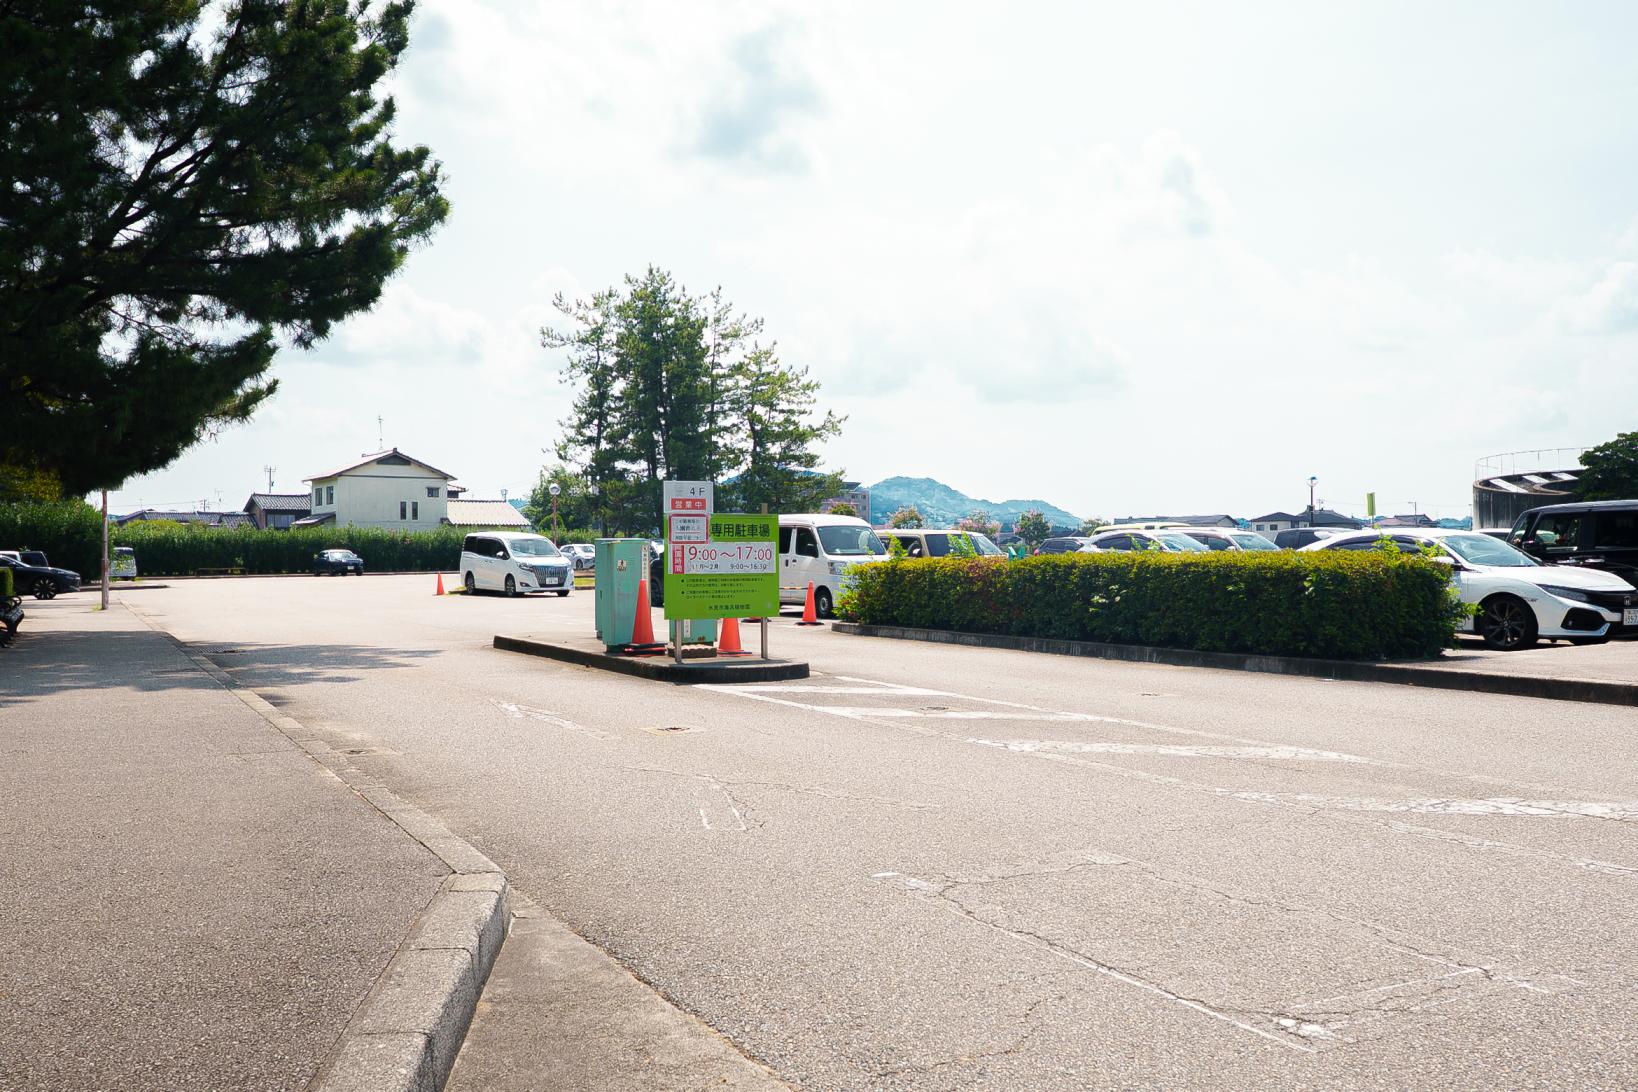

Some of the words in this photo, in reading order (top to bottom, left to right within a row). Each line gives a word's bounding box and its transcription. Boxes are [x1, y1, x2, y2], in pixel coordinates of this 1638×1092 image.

[674, 500, 703, 509] 営業中
[711, 523, 770, 537] 専用駐車場
